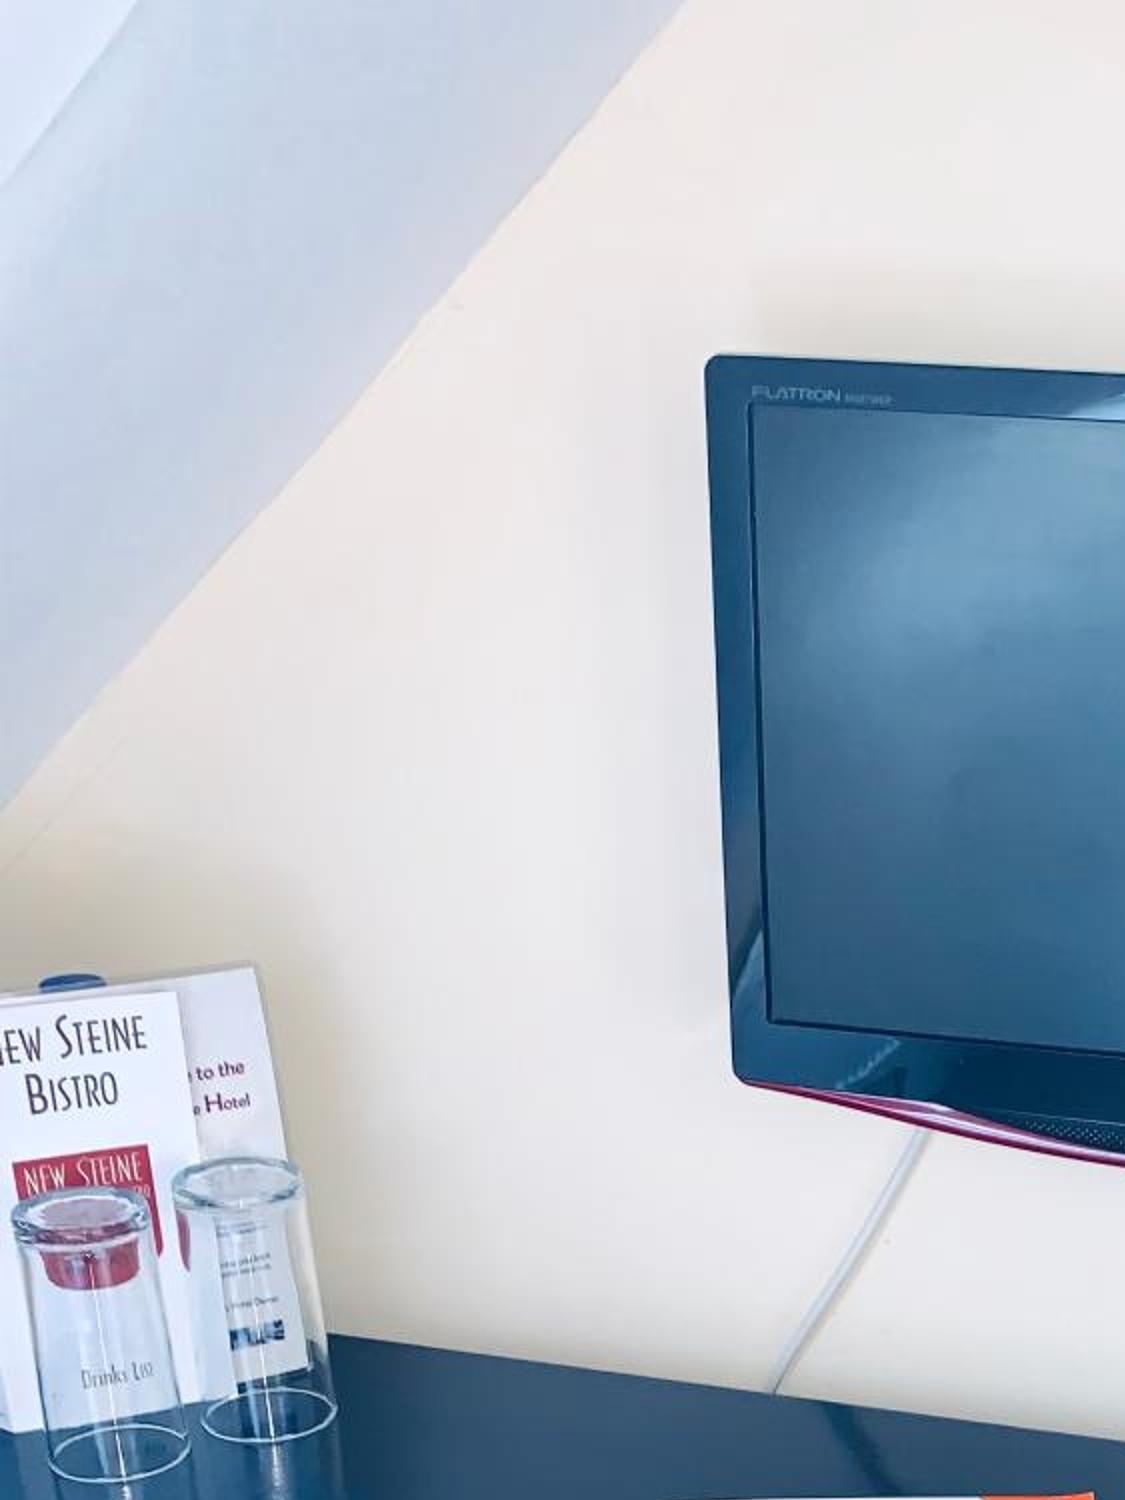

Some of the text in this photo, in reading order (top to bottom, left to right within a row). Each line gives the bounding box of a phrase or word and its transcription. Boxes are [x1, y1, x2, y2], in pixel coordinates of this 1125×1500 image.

[752, 385, 840, 401] FLATRON
[56, 1014, 148, 1059] STEINE
[196, 1066, 215, 1082] to
[218, 1061, 245, 1077] the
[26, 1071, 119, 1115] BISTRO
[203, 1093, 251, 1113] Hotel
[23, 1151, 145, 1196] NEW STEINE
